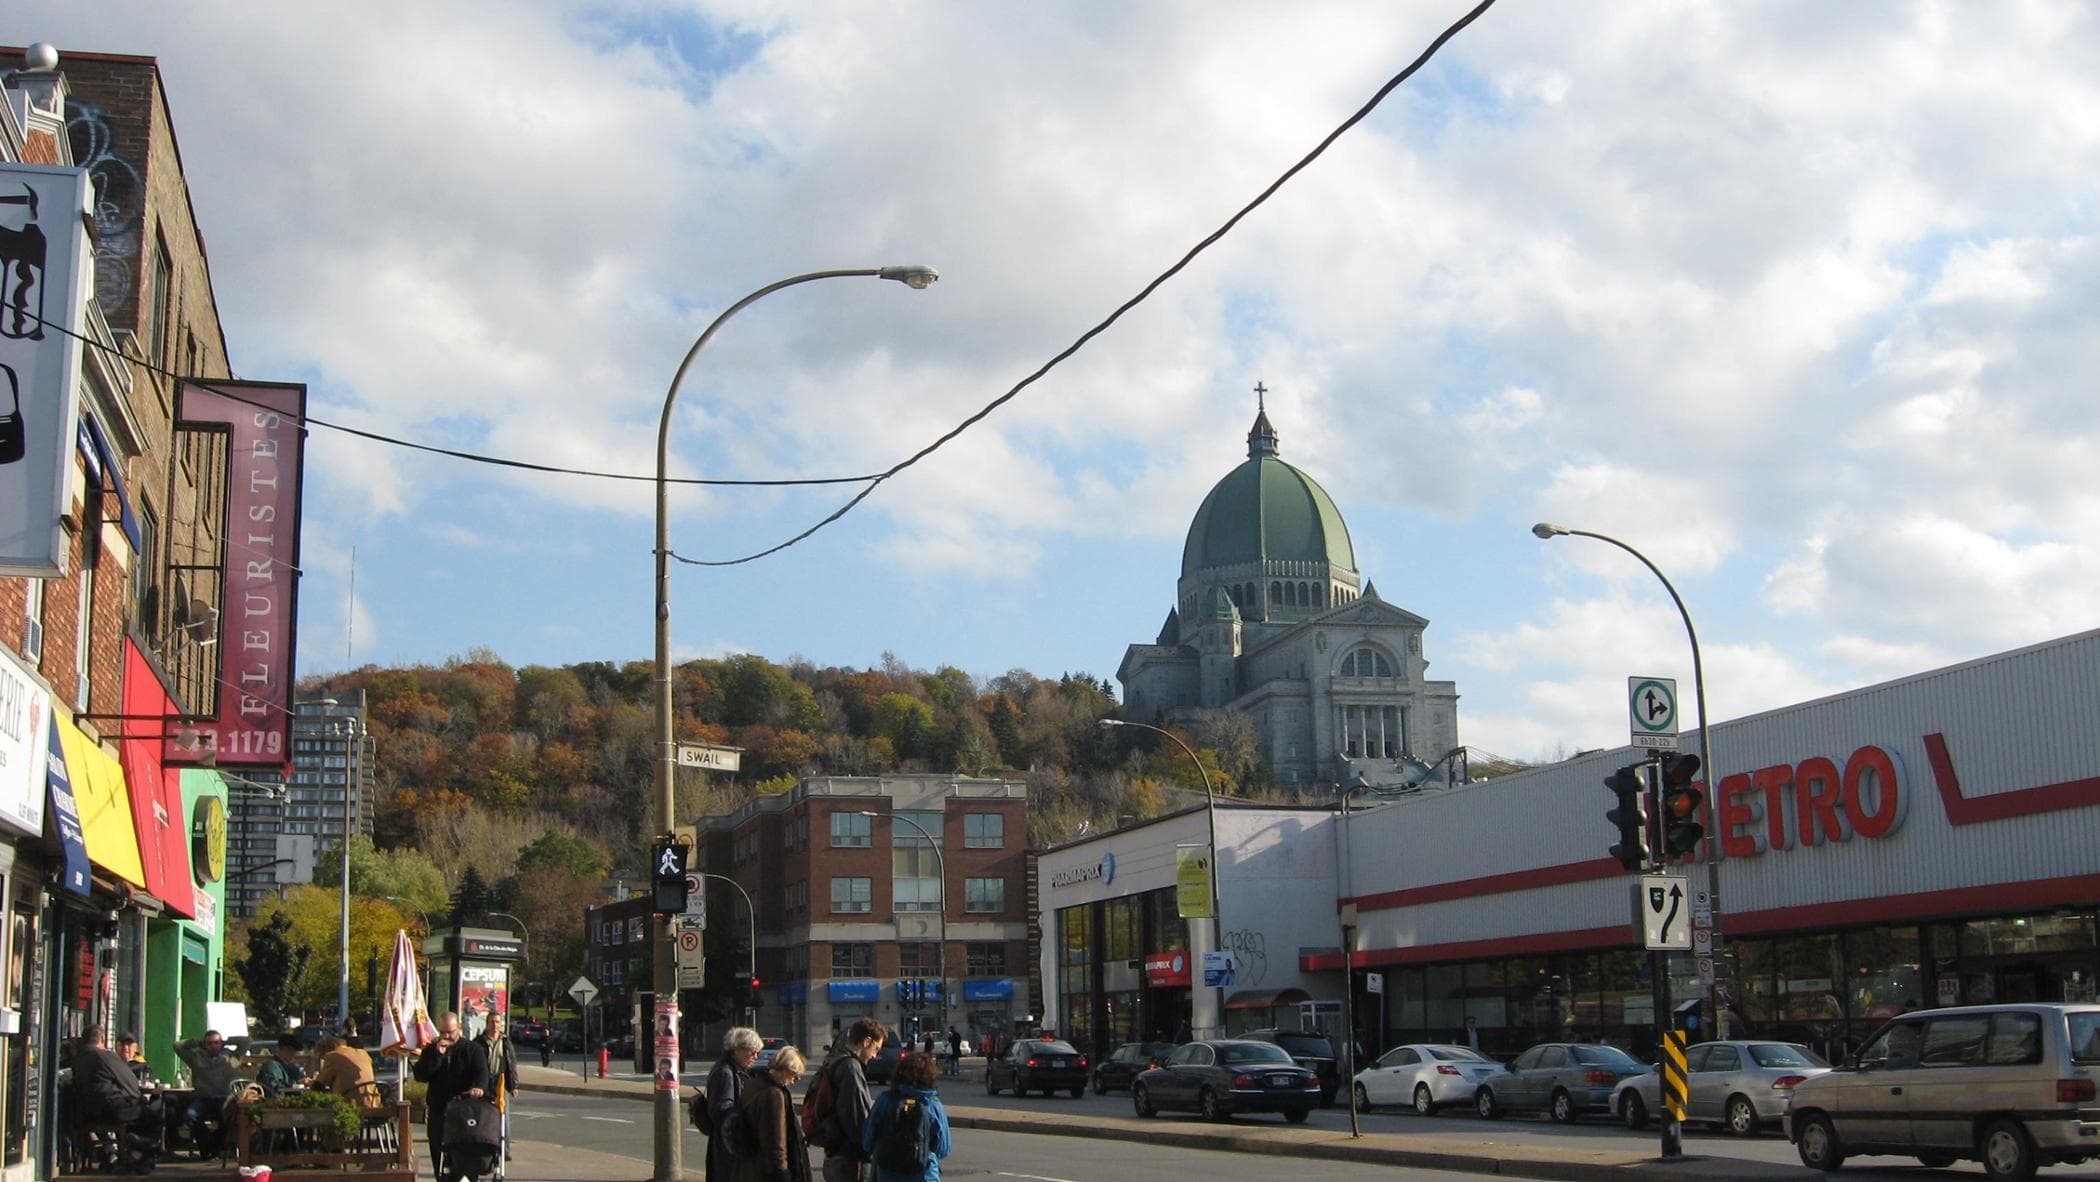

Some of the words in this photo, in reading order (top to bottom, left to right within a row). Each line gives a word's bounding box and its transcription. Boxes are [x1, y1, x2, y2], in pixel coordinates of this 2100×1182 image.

[241, 411, 280, 716] FLEURISTES
[686, 751, 720, 765] SWAIL
[1645, 745, 1898, 863] ETRO
[463, 968, 506, 981] CEPSUM
